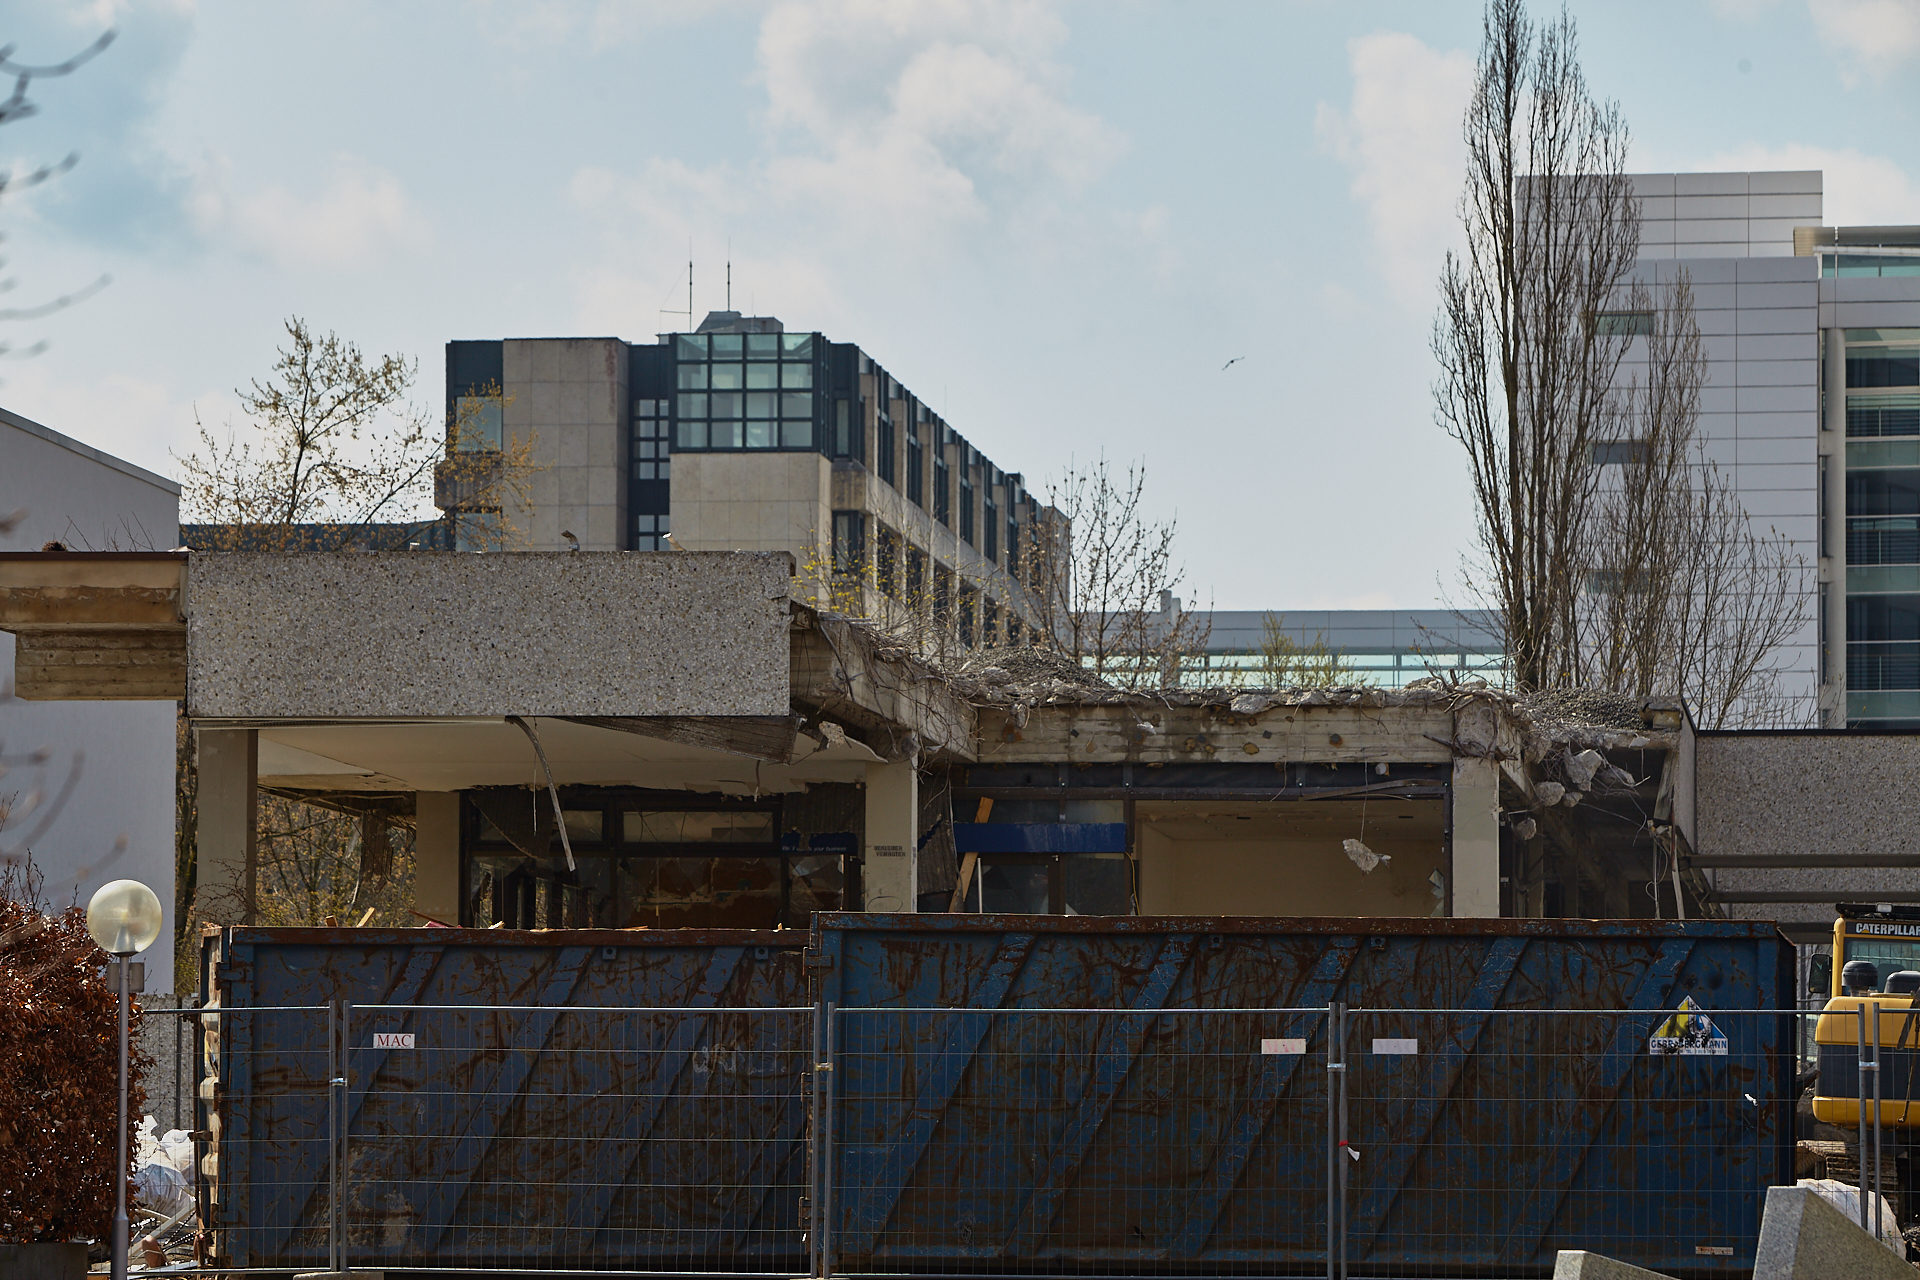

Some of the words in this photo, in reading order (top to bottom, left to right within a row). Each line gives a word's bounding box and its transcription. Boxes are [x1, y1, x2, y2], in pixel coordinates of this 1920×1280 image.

[1856, 922, 1920, 936] CATERPILLAR
[377, 1034, 412, 1047] MAC
[1264, 1040, 1303, 1053] MAC
